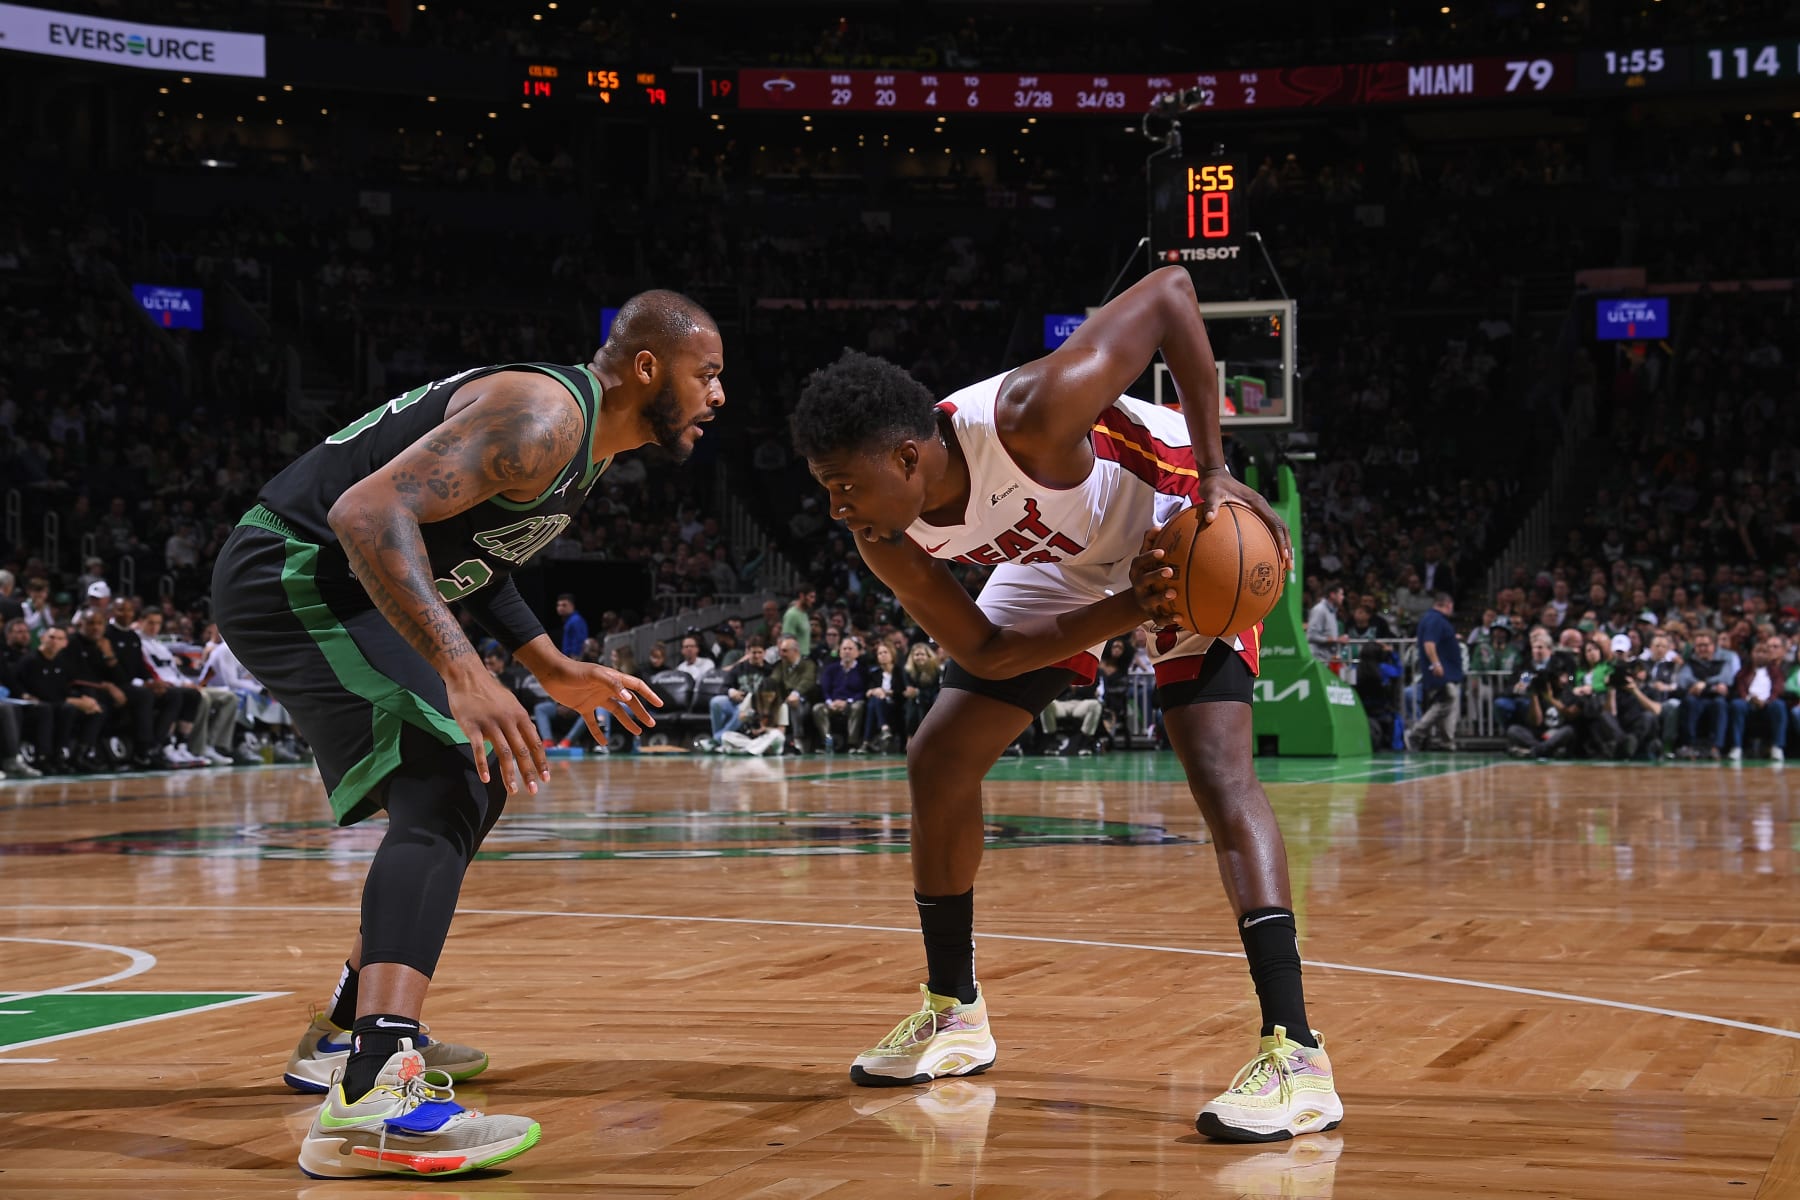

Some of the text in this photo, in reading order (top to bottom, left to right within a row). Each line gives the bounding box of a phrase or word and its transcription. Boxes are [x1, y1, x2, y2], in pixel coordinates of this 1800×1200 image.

[48, 22, 216, 62] EVERSOURCE
[1605, 48, 1664, 74] 1:55
[1708, 45, 1781, 80] 114
[587, 70, 620, 89] 1:55
[874, 75, 896, 86] AST
[964, 76, 980, 87] TO
[1408, 59, 1554, 96] MIAMI 79
[523, 80, 551, 97] 114
[645, 88, 667, 105] 79
[710, 79, 732, 97] 19
[831, 89, 852, 106] 29
[875, 90, 897, 107] 20
[925, 90, 937, 107] 4
[967, 91, 979, 108] 6
[1014, 91, 1054, 109] 3/28
[1076, 91, 1126, 109] 34/83
[1245, 87, 1257, 104] 2
[1187, 164, 1235, 193] 1:55
[1187, 191, 1230, 239] 18
[1180, 246, 1240, 262] TISSOT
[143, 296, 192, 312] ULTRA
[1607, 309, 1656, 323] ULTRA
[952, 497, 1053, 565] EAT
